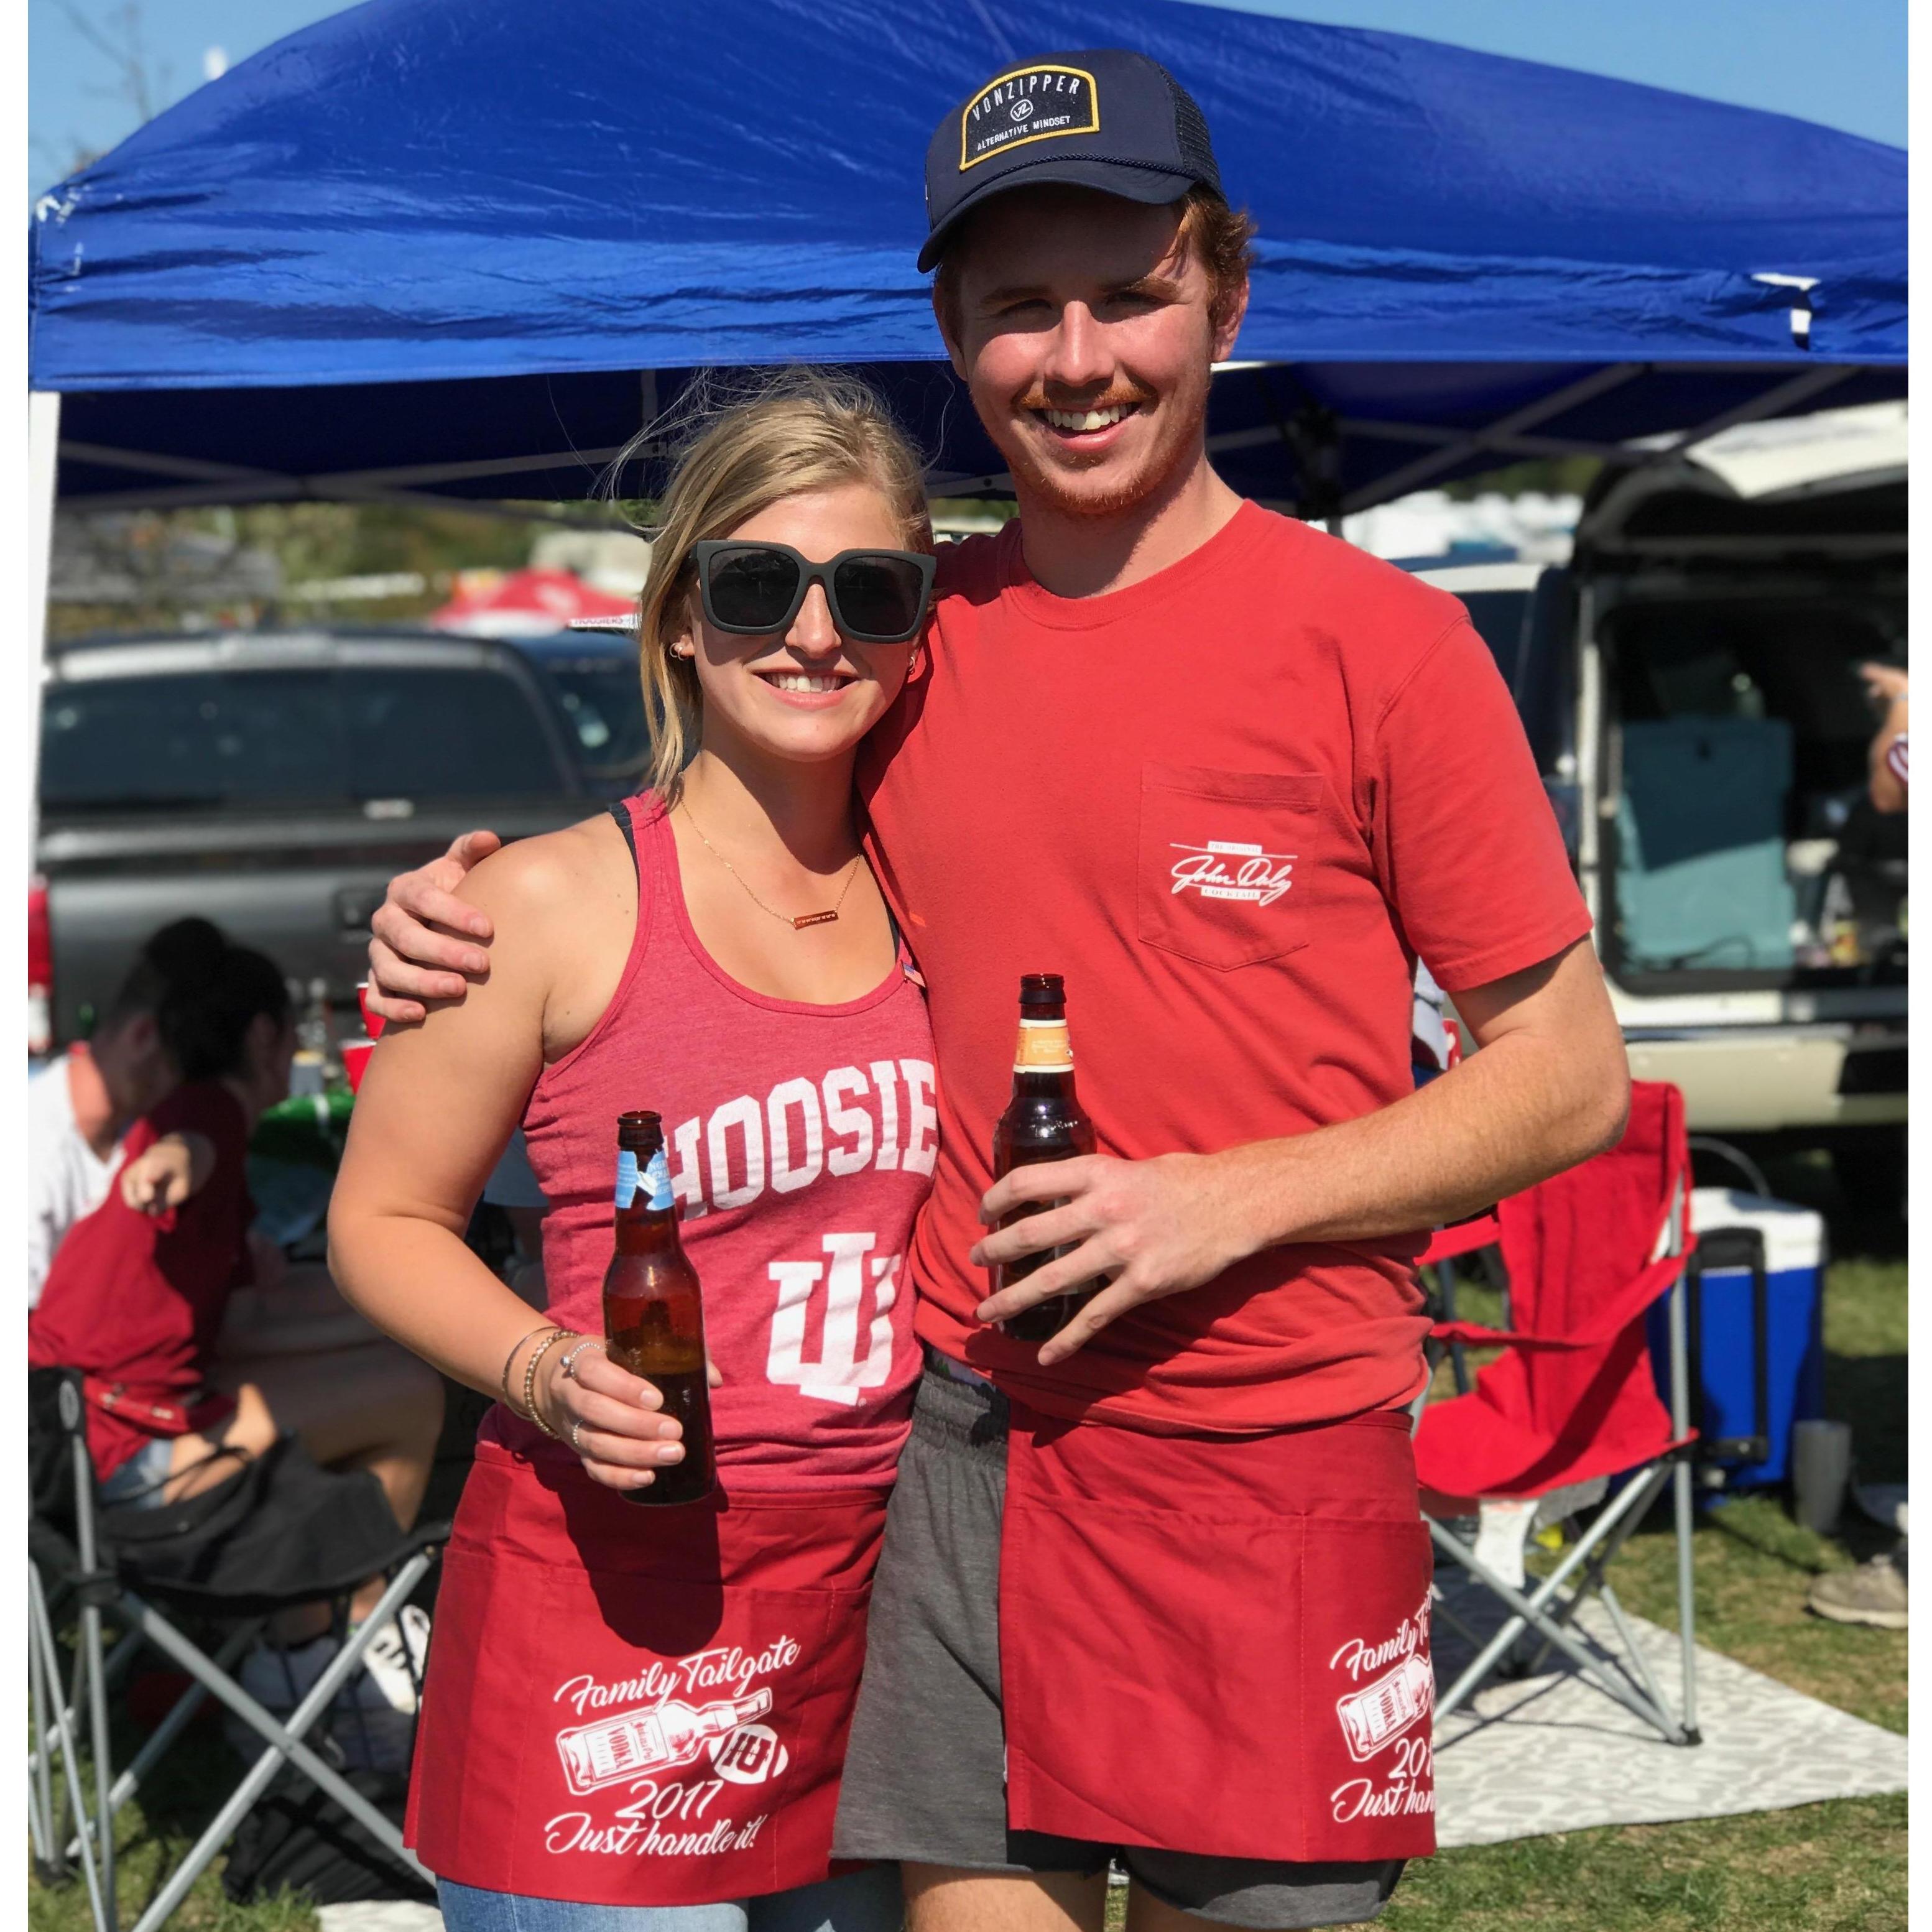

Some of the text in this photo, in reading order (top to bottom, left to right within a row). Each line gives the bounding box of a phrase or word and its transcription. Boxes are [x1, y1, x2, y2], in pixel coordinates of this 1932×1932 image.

[973, 75, 1080, 121] VONZIPPER
[977, 116, 1071, 151] ALTERNATIVE MINDSET
[1171, 855, 1236, 894] John
[1204, 889, 1258, 898] COCKTAIL
[1330, 1619, 1418, 1681] Family
[553, 1635, 801, 1716] Family Tailgate
[1379, 1688, 1397, 1731] VODKA
[608, 1727, 634, 1769] VODKA
[616, 1780, 724, 1819] 2017
[1331, 1778, 1408, 1823] Just
[545, 1812, 767, 1856] Just handle it!
